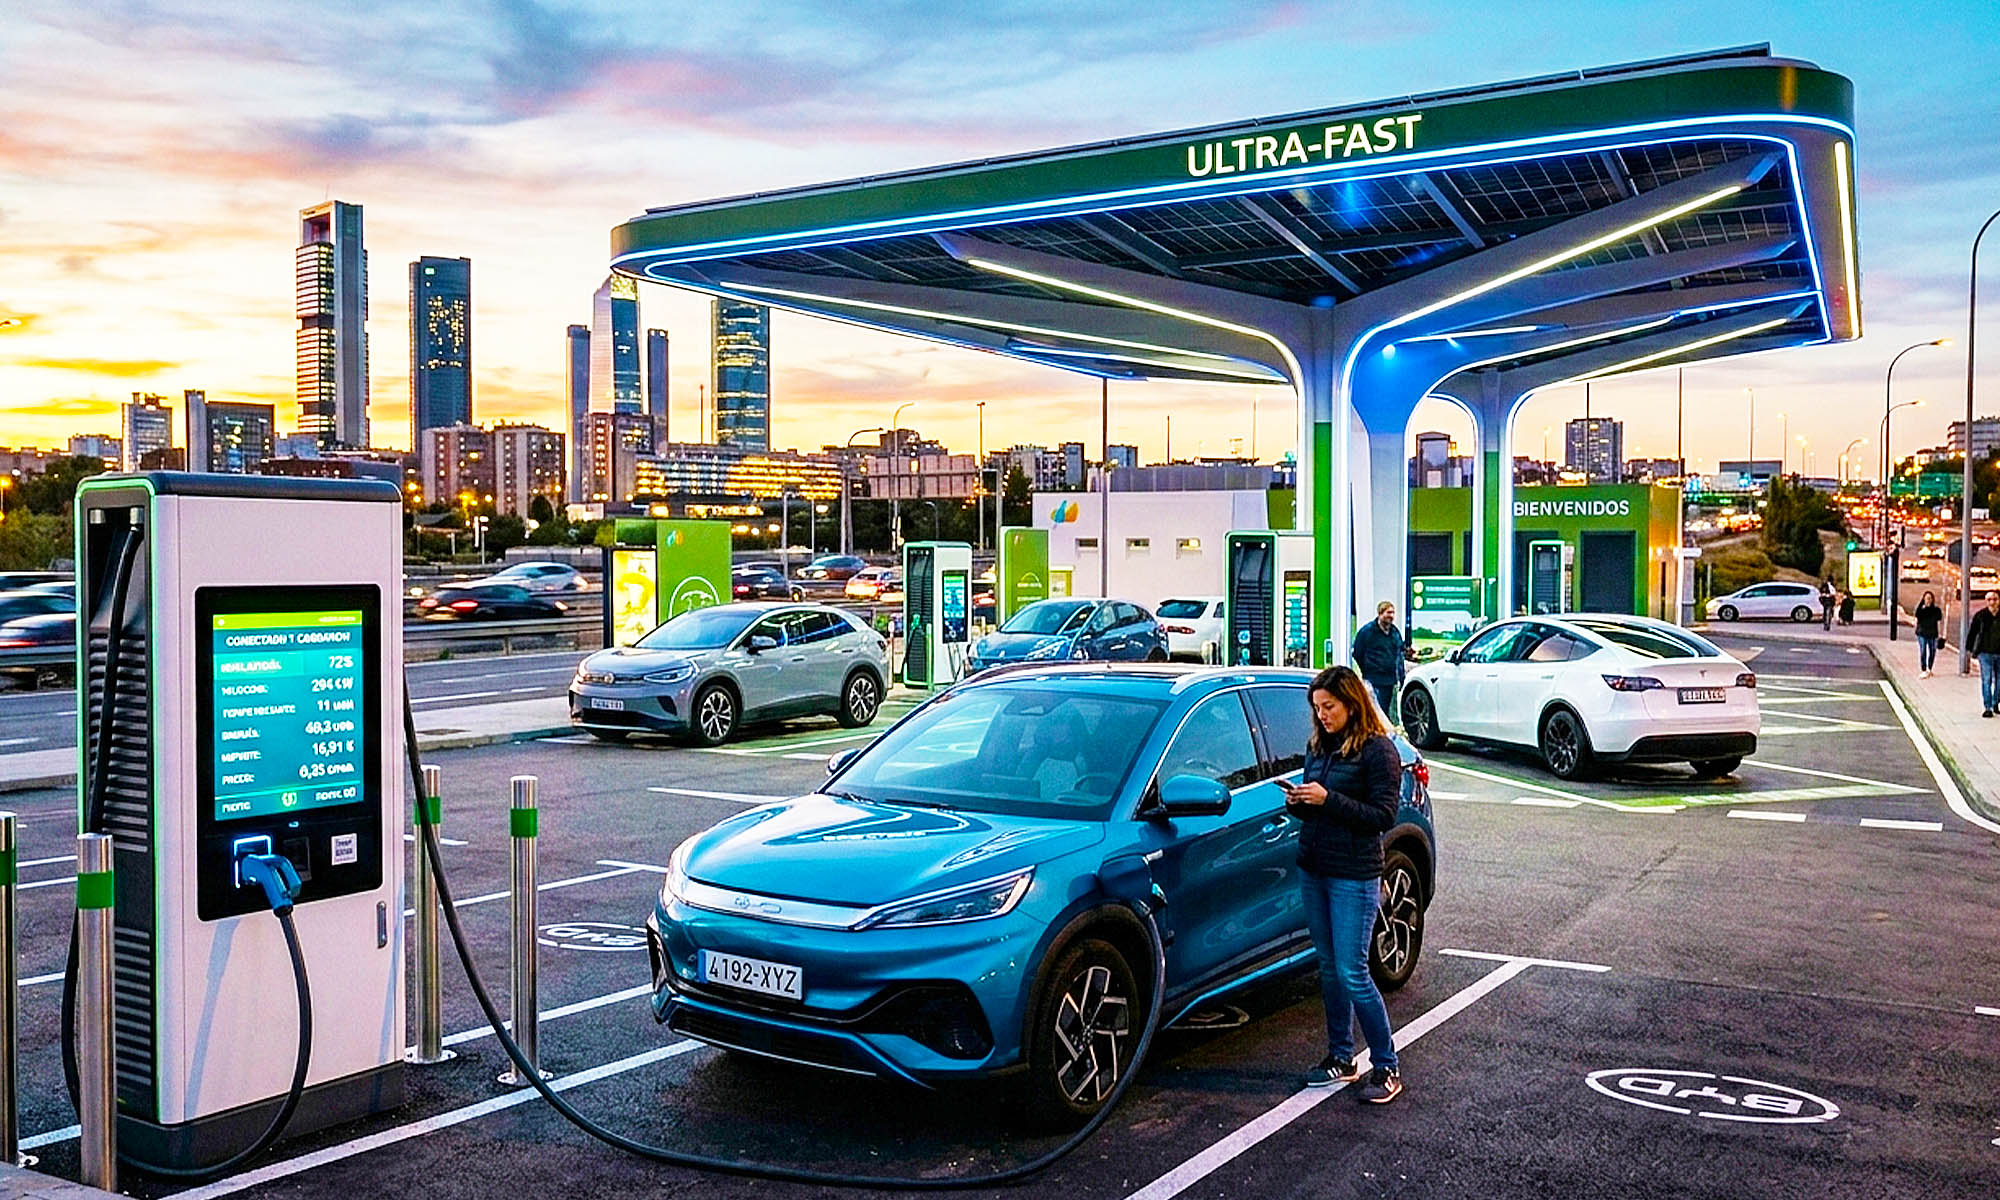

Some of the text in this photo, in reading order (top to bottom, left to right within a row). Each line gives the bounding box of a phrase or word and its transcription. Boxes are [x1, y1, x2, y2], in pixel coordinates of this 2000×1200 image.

[1187, 113, 1423, 177] ULTRA-FAST
[1513, 500, 1630, 517] BIENVENIDOS
[709, 956, 797, 994] 4192-XYZ
